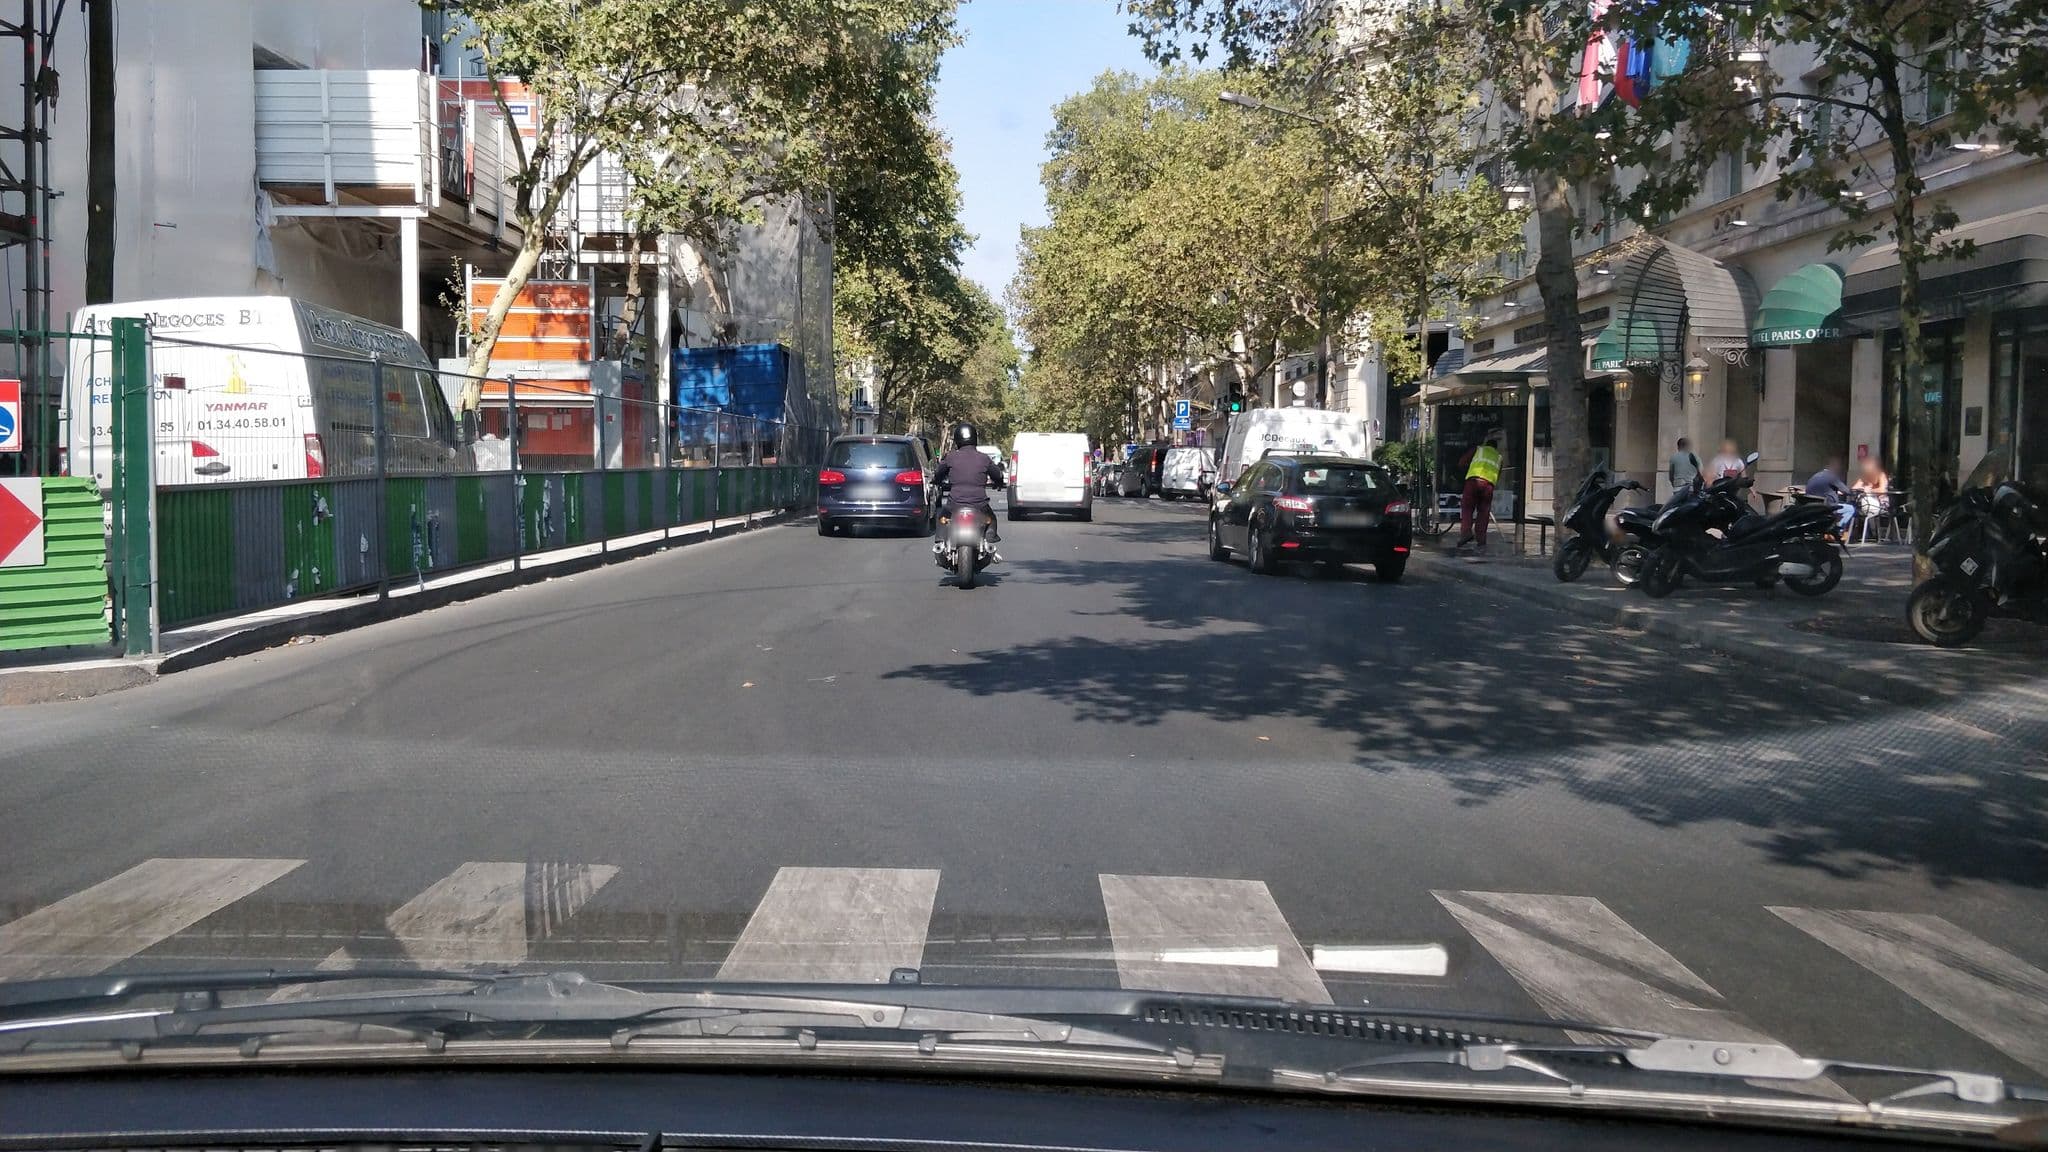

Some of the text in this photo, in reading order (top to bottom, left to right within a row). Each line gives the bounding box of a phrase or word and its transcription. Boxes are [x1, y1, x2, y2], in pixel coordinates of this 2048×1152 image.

[144, 312, 224, 329] NEGOCES
[205, 402, 268, 412] YANMAR
[197, 417, 286, 431] 01.34.40.58.01
